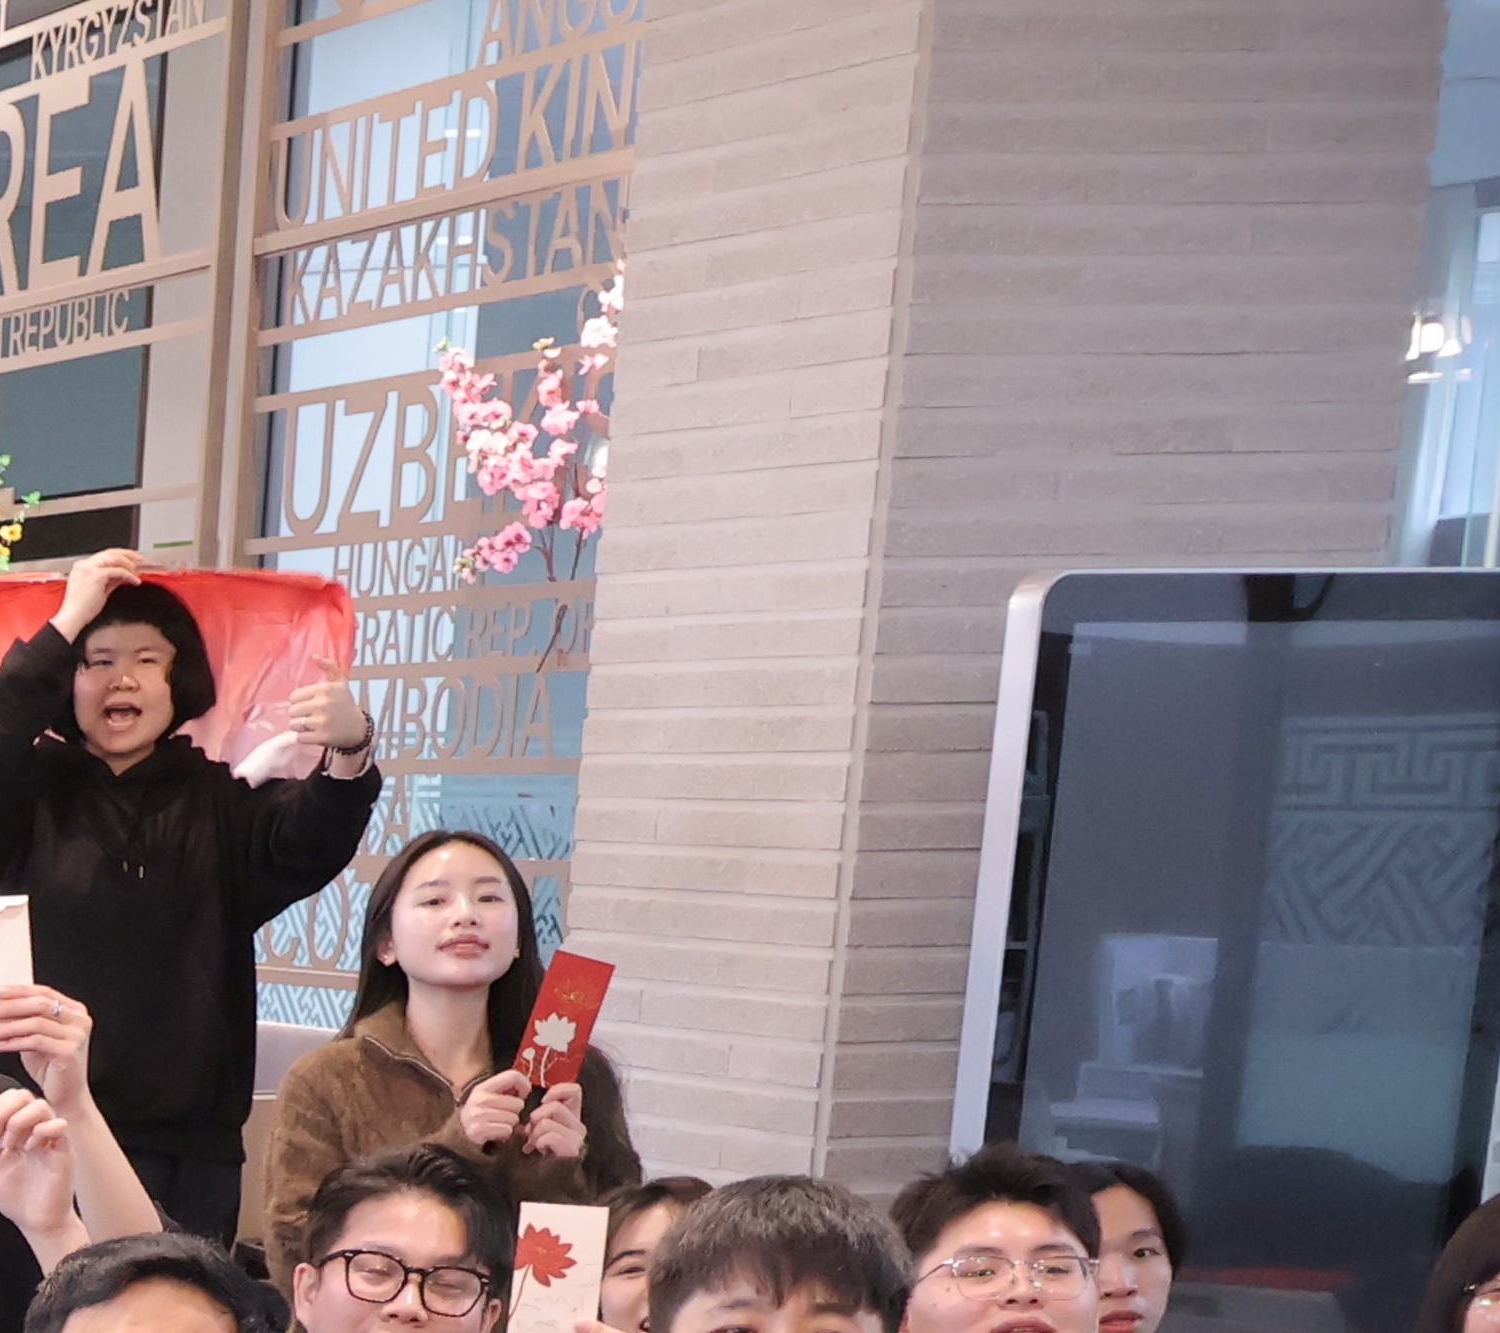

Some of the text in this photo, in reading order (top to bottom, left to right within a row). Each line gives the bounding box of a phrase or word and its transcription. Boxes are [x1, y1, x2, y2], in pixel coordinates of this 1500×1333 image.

[272, 81, 499, 227] UNITED
[287, 172, 626, 326] KAZAKHSTAN
[10, 291, 129, 354] REPUBLIC
